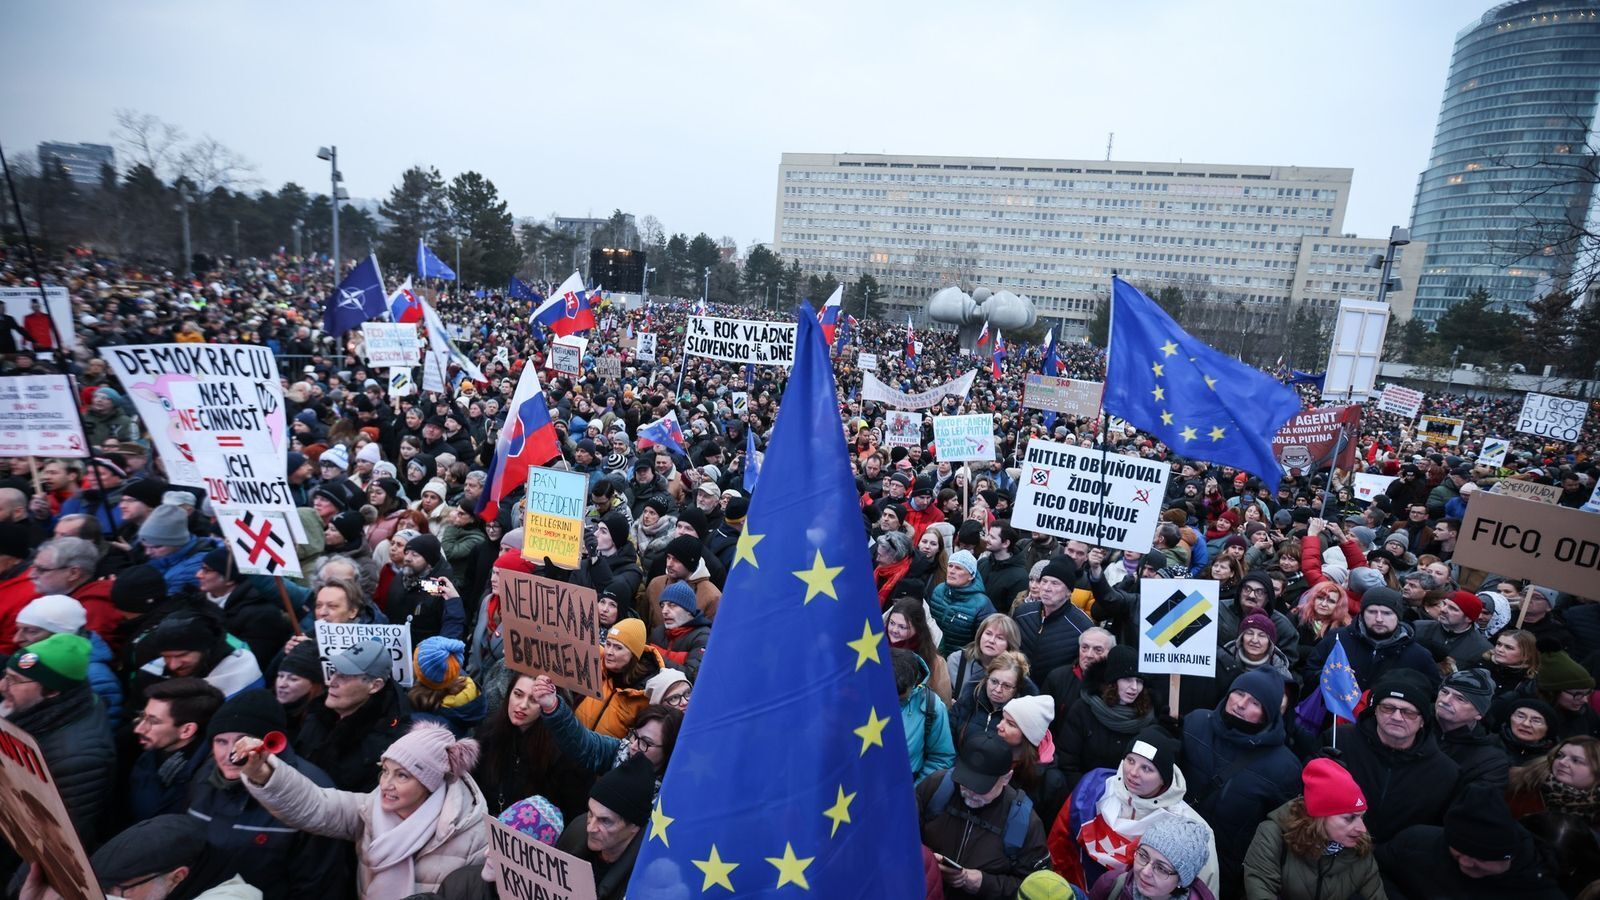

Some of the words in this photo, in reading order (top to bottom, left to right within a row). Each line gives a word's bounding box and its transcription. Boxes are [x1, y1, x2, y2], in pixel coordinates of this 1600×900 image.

[692, 318, 708, 336] 14.
[714, 321, 739, 340] ROK
[743, 323, 795, 344] VLÁDNE
[687, 336, 749, 359] SLOVENSKO
[751, 343, 761, 353] JE
[756, 352, 768, 361] NA
[770, 345, 793, 361] DNE
[114, 347, 271, 380] DEMOKRACIU
[198, 381, 243, 407] NAŠA
[178, 404, 261, 431] NEČINNOSŤ
[1293, 424, 1321, 434] KRVAVÝ
[1295, 412, 1337, 426] AGENT
[1299, 433, 1332, 443] PUTINA
[1520, 420, 1578, 441] PUCO
[223, 454, 255, 478] ICH
[1028, 447, 1077, 470] HITLER
[1079, 456, 1162, 484] OBVIŇOVAL
[203, 476, 290, 505] ZLOČINNOSŤ
[533, 472, 557, 489] PÁN
[1067, 473, 1113, 497] ŽIDOV
[531, 491, 583, 517] PREZIDENT
[1033, 492, 1066, 511] FICO
[1068, 498, 1139, 523] OBVIŇUJE
[531, 515, 572, 532] PELLEGRINI
[1036, 513, 1128, 543] UKRAJINCOV
[1472, 517, 1541, 558] FICO,
[1554, 537, 1600, 571] OD
[320, 625, 401, 637] SLOVENSKO
[320, 635, 336, 645] JE
[510, 629, 601, 698] BOJUJEM!
[1144, 653, 1165, 663] MIER
[1168, 653, 1211, 666] UKRAJINE
[491, 823, 573, 892] NECHCEME
